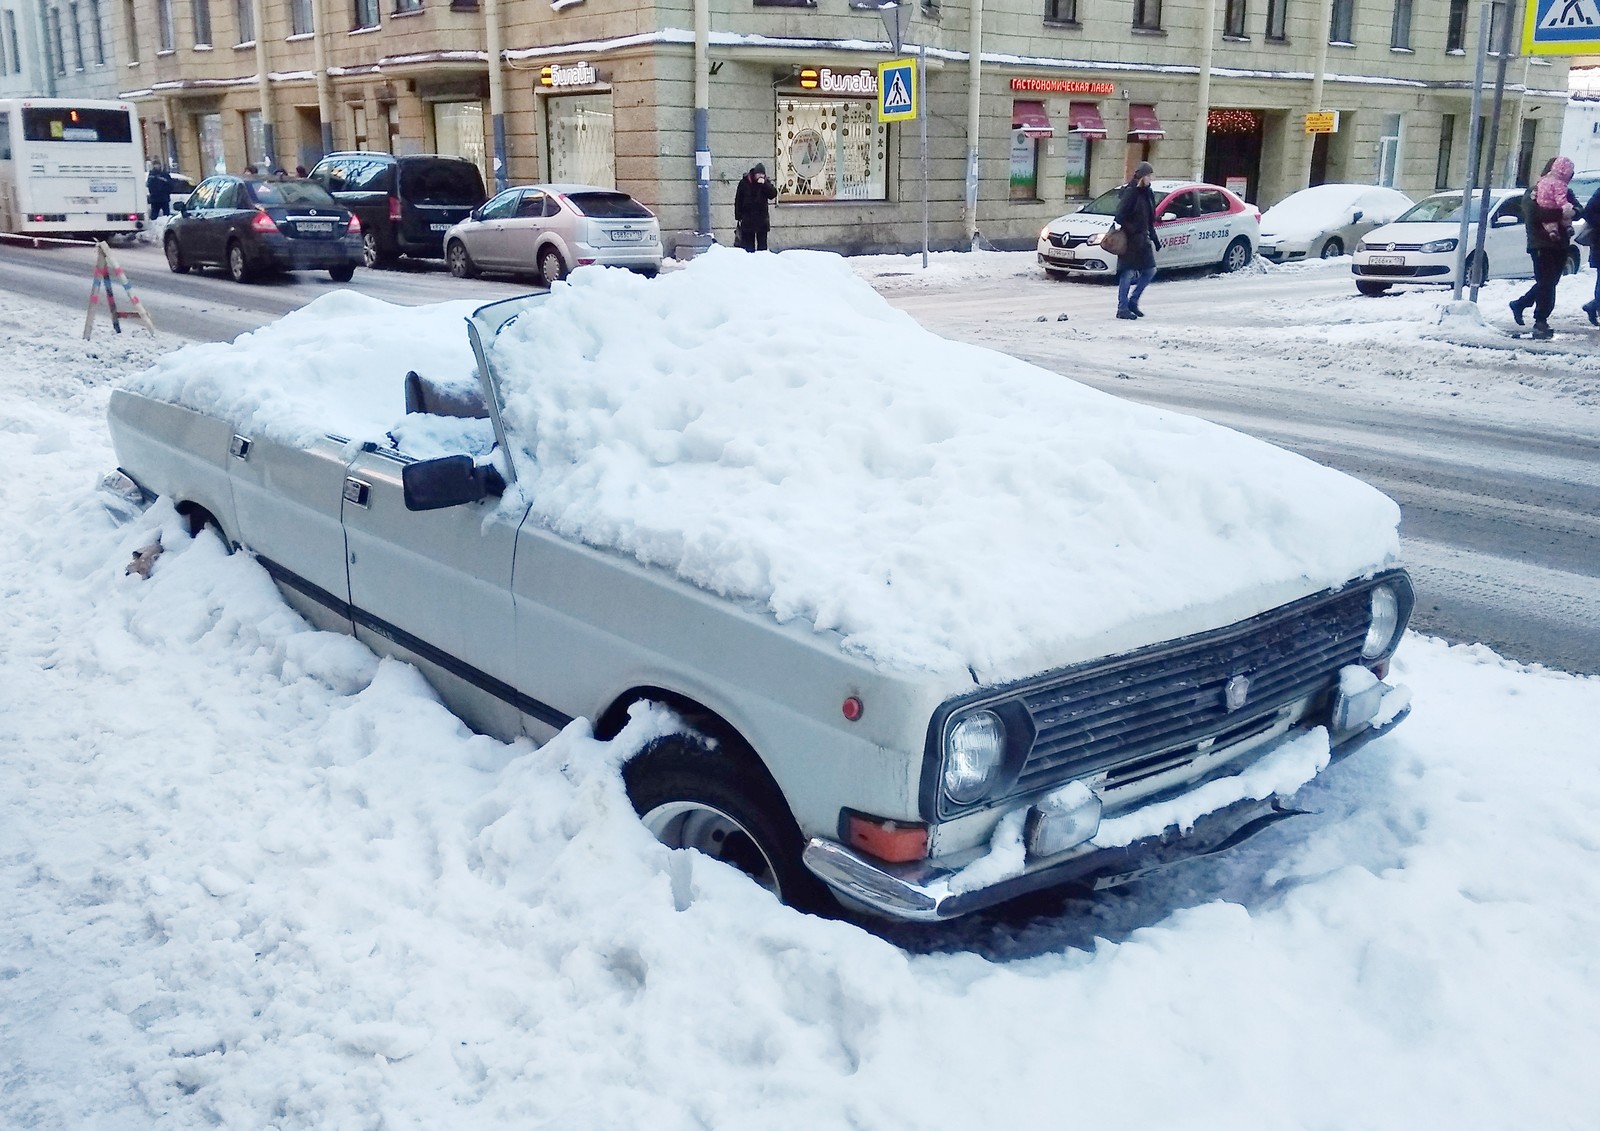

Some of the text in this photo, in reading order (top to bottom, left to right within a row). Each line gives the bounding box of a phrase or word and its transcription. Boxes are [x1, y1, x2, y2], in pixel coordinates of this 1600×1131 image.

[1012, 78, 1114, 94] ГАСТРОНОМИЧЕСКАЯ ЛАВКА
[1198, 229, 1230, 241] 318-0-318
